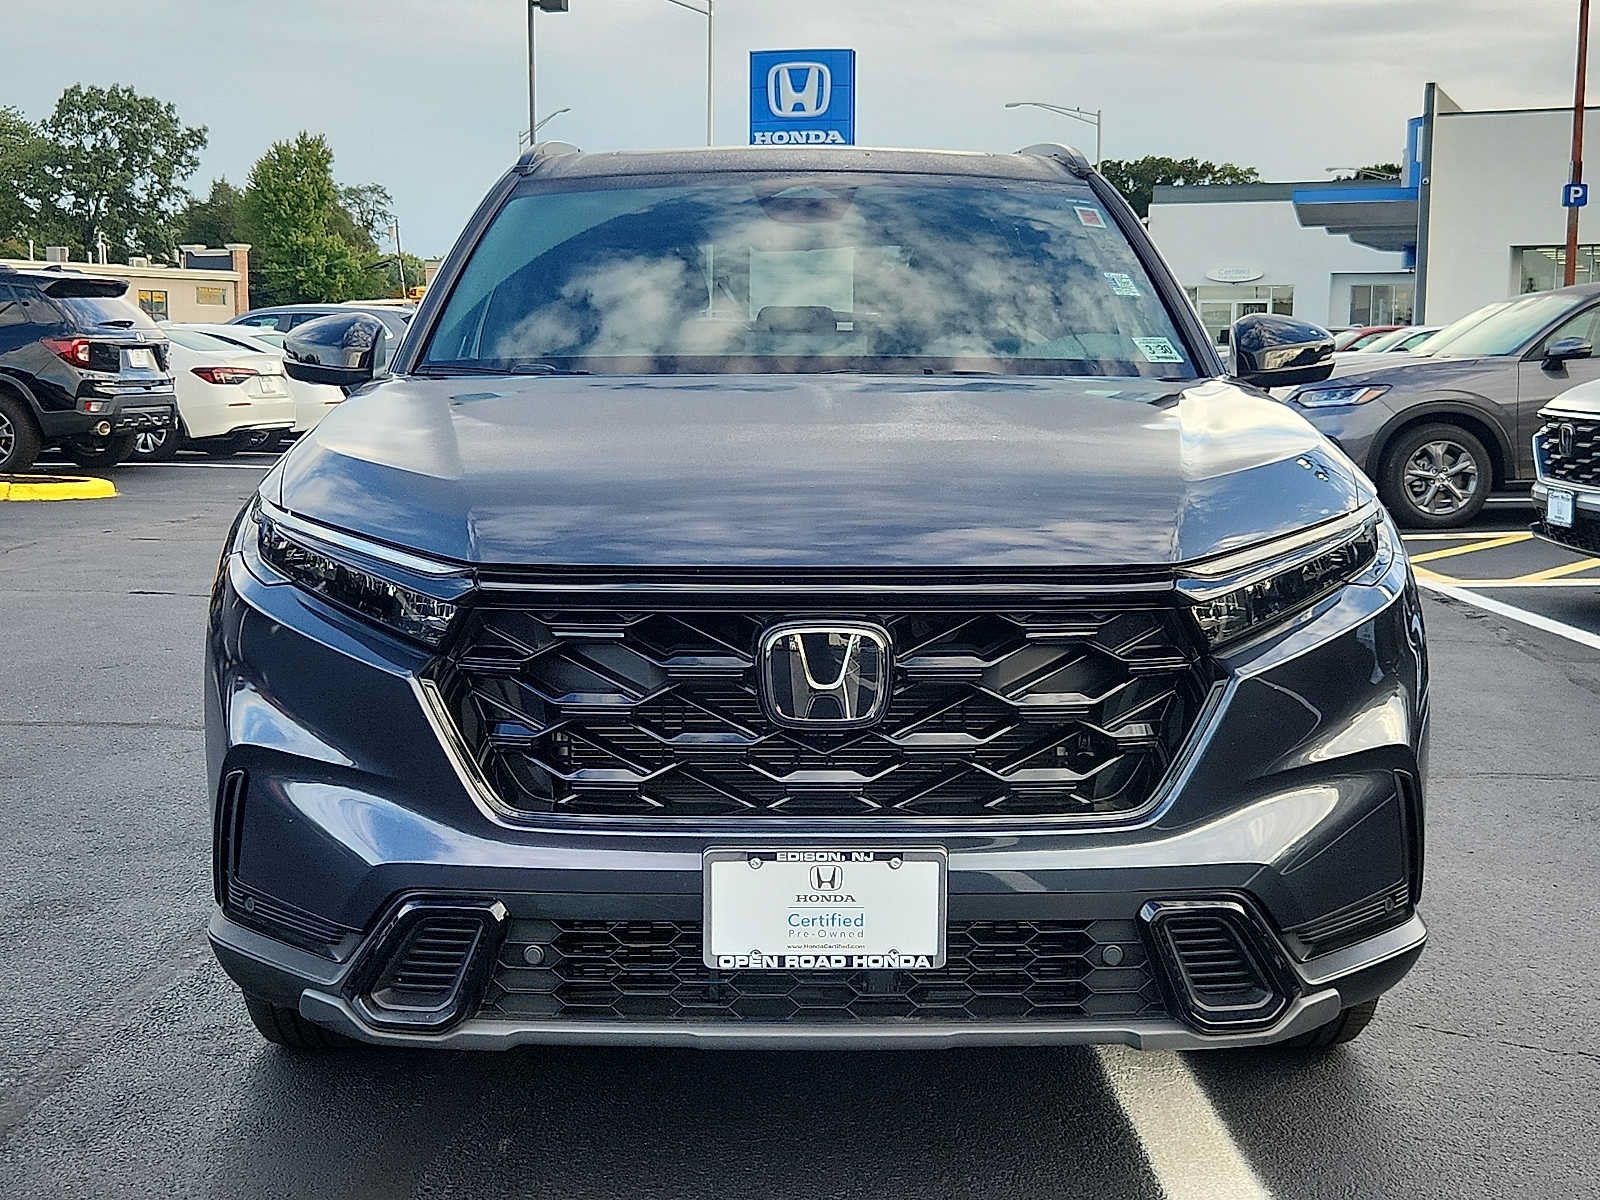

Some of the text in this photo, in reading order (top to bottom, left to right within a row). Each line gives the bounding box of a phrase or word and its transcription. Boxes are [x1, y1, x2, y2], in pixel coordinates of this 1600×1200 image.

[754, 130, 846, 145] HONDA
[1570, 186, 1583, 204] P
[776, 851, 874, 862] EDISON, NJ
[795, 894, 857, 903] HONDA
[788, 912, 864, 928] Certified
[788, 929, 864, 938] Pre-Owned
[718, 955, 931, 969] OPEN ROAD HONDA
